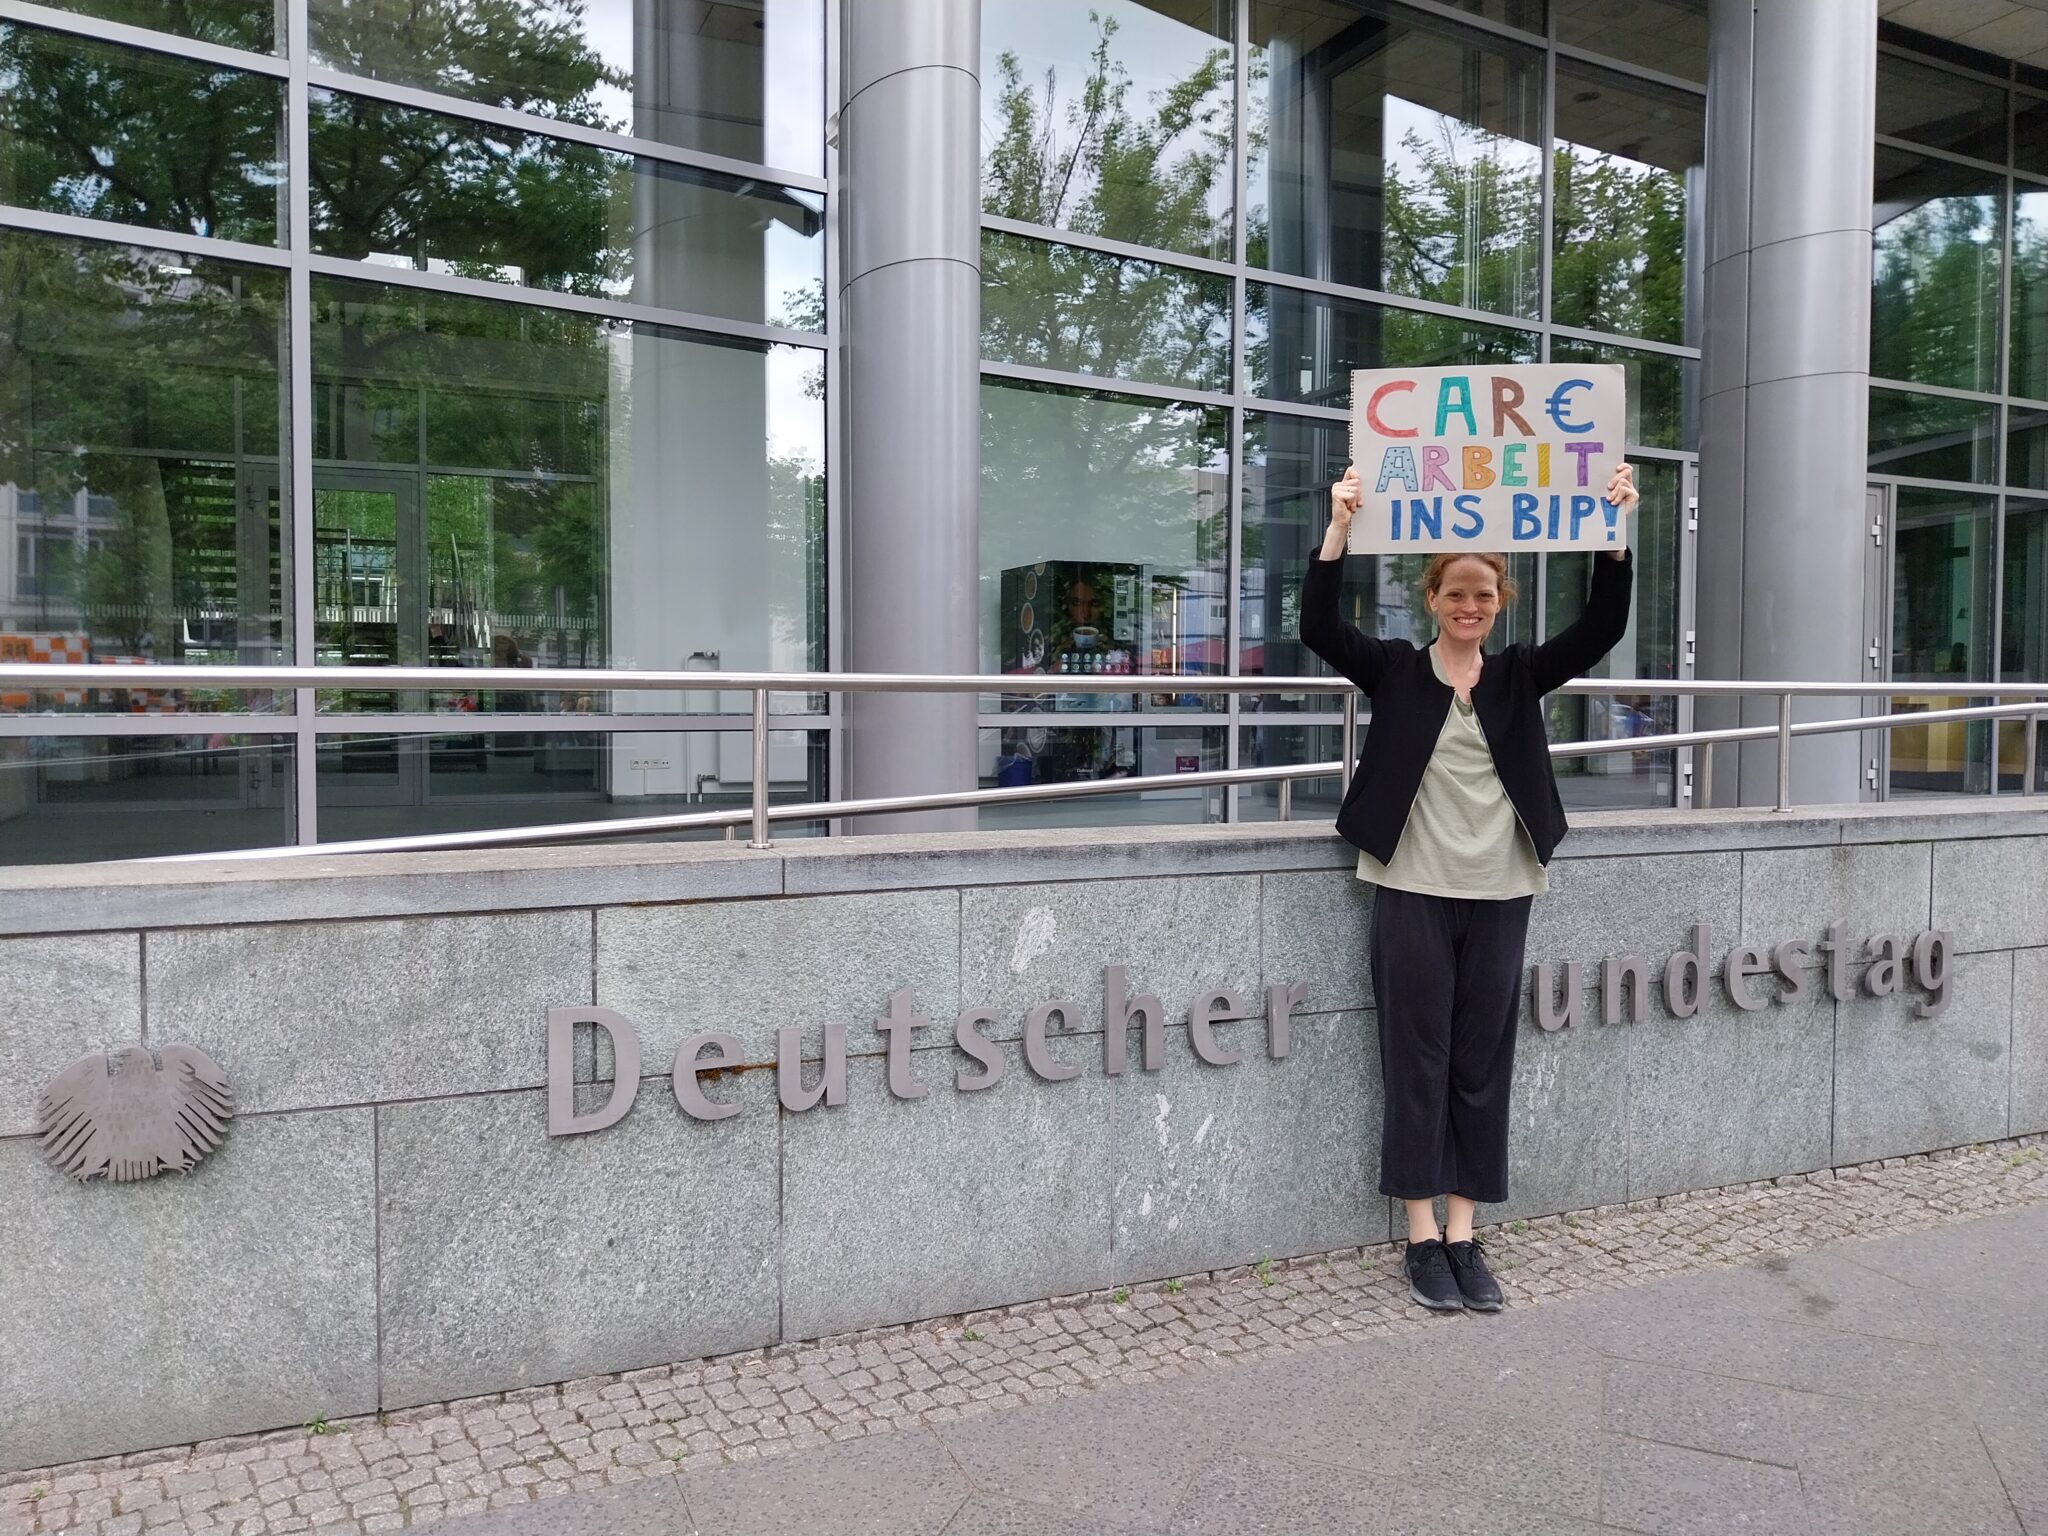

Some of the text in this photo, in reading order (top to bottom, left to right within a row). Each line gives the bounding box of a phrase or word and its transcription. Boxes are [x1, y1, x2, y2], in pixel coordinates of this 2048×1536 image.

[1366, 376, 1595, 437] CAR€
[1375, 442, 1604, 492] ARBEIT
[1391, 492, 1619, 541] INS BIP!
[548, 917, 1955, 1137] Deutscher undestag
